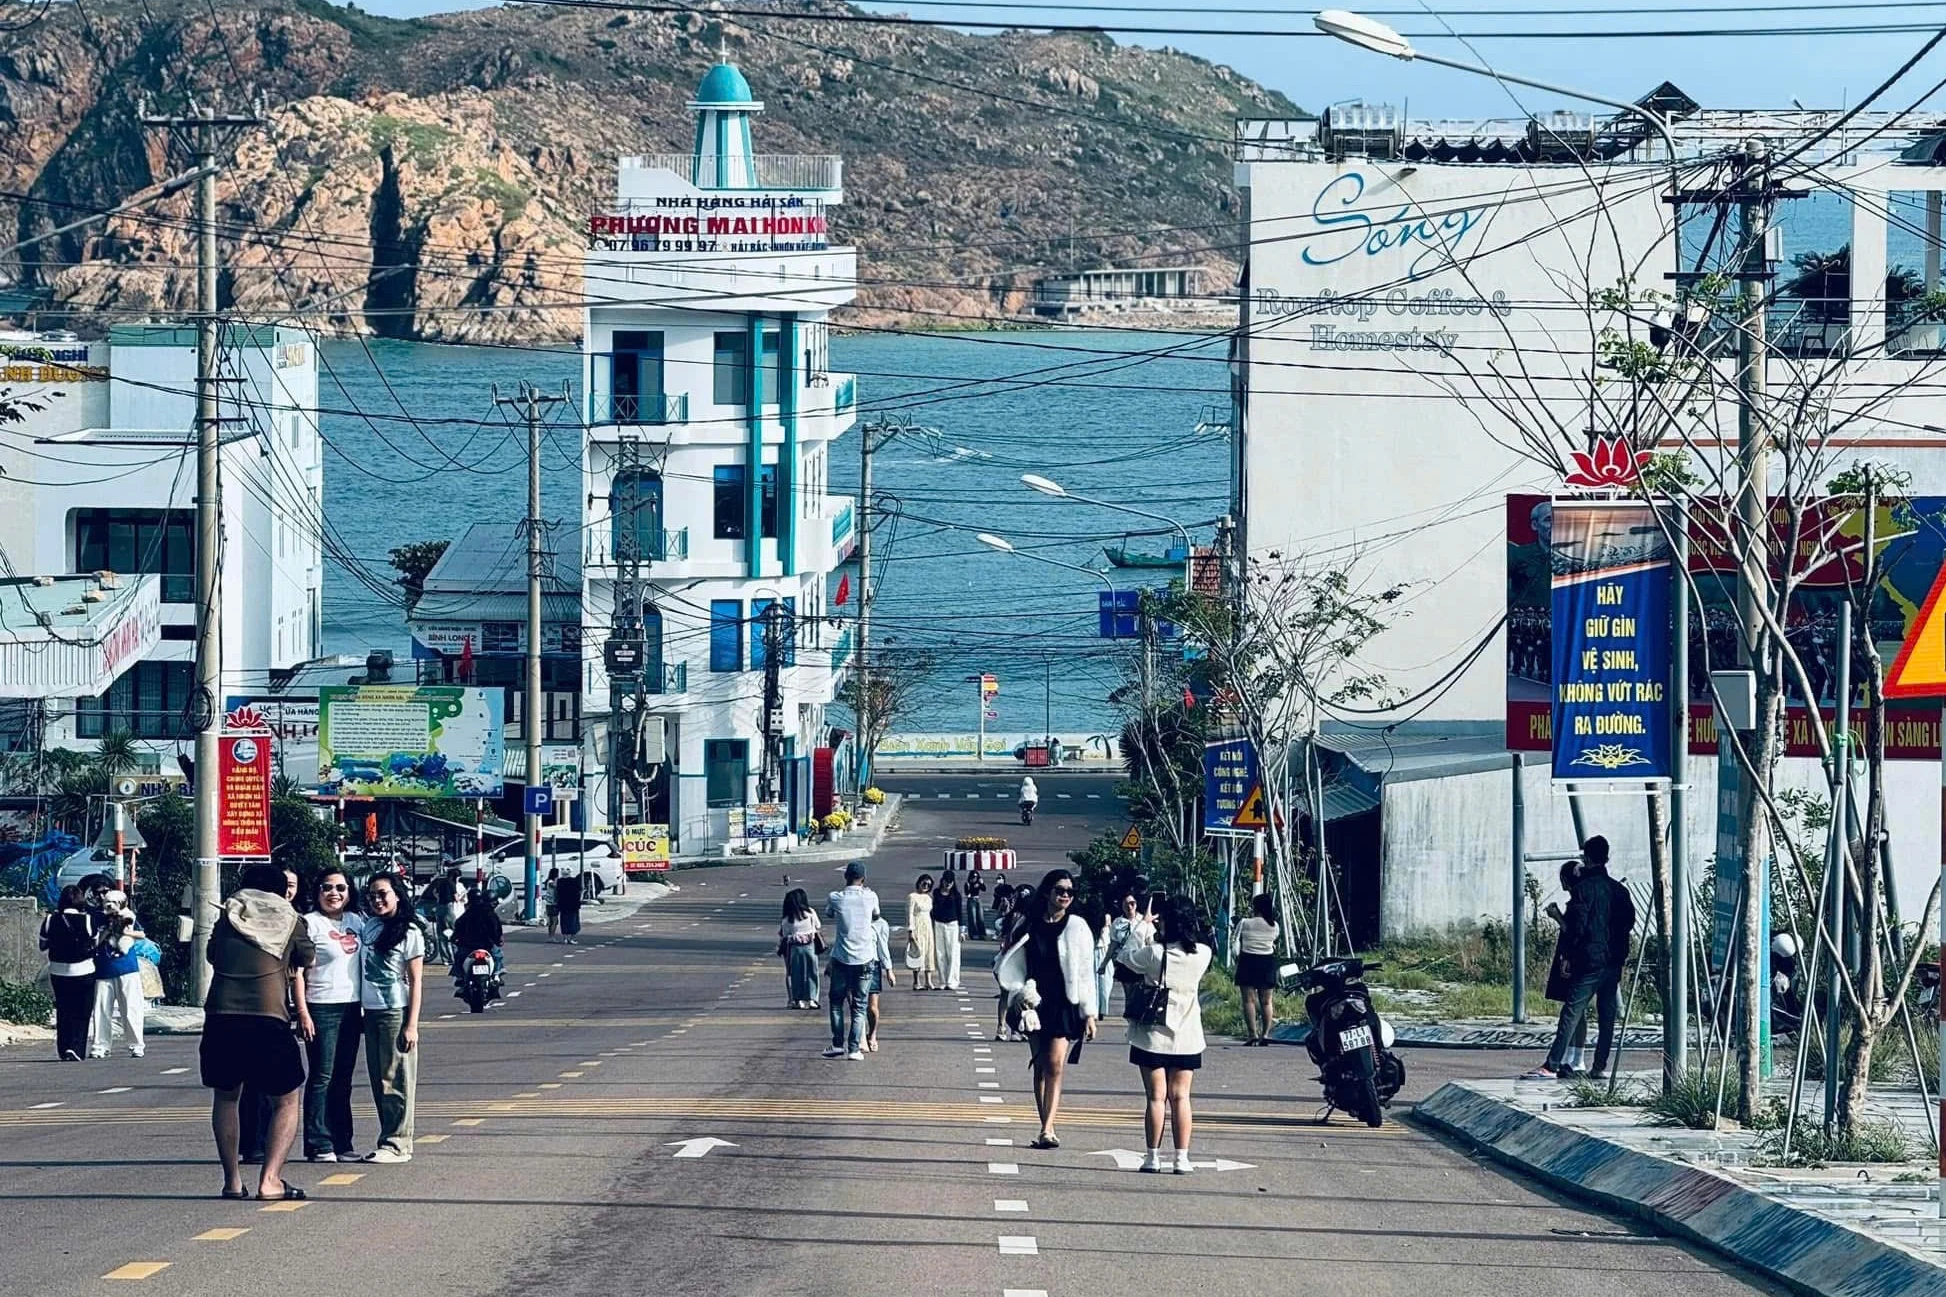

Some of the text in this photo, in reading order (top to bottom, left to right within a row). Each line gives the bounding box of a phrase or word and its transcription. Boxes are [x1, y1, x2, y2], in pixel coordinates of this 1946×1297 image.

[656, 194, 804, 209] NHÀ HÀNG HẢI SẢN
[590, 214, 699, 235] PHƯƠNG
[707, 217, 757, 235] MAI
[762, 210, 804, 235] HÒN
[632, 240, 649, 252] 96
[675, 240, 692, 252] 99
[698, 240, 716, 252] 97
[1256, 287, 1512, 322] Rooftop Coffee &
[1596, 582, 1624, 605] HÃY
[1585, 614, 1636, 638] GIỮ GÌN
[1582, 647, 1639, 674] VỆ SINH,
[1559, 679, 1663, 702] KHÔNG VỨT RÁC
[1530, 710, 1553, 740] PHÁ
[1897, 716, 1930, 748] SÀNG
[1574, 711, 1646, 735] RA ĐƯỜNG.
[535, 793, 549, 808] P
[625, 837, 657, 852] CÚC
